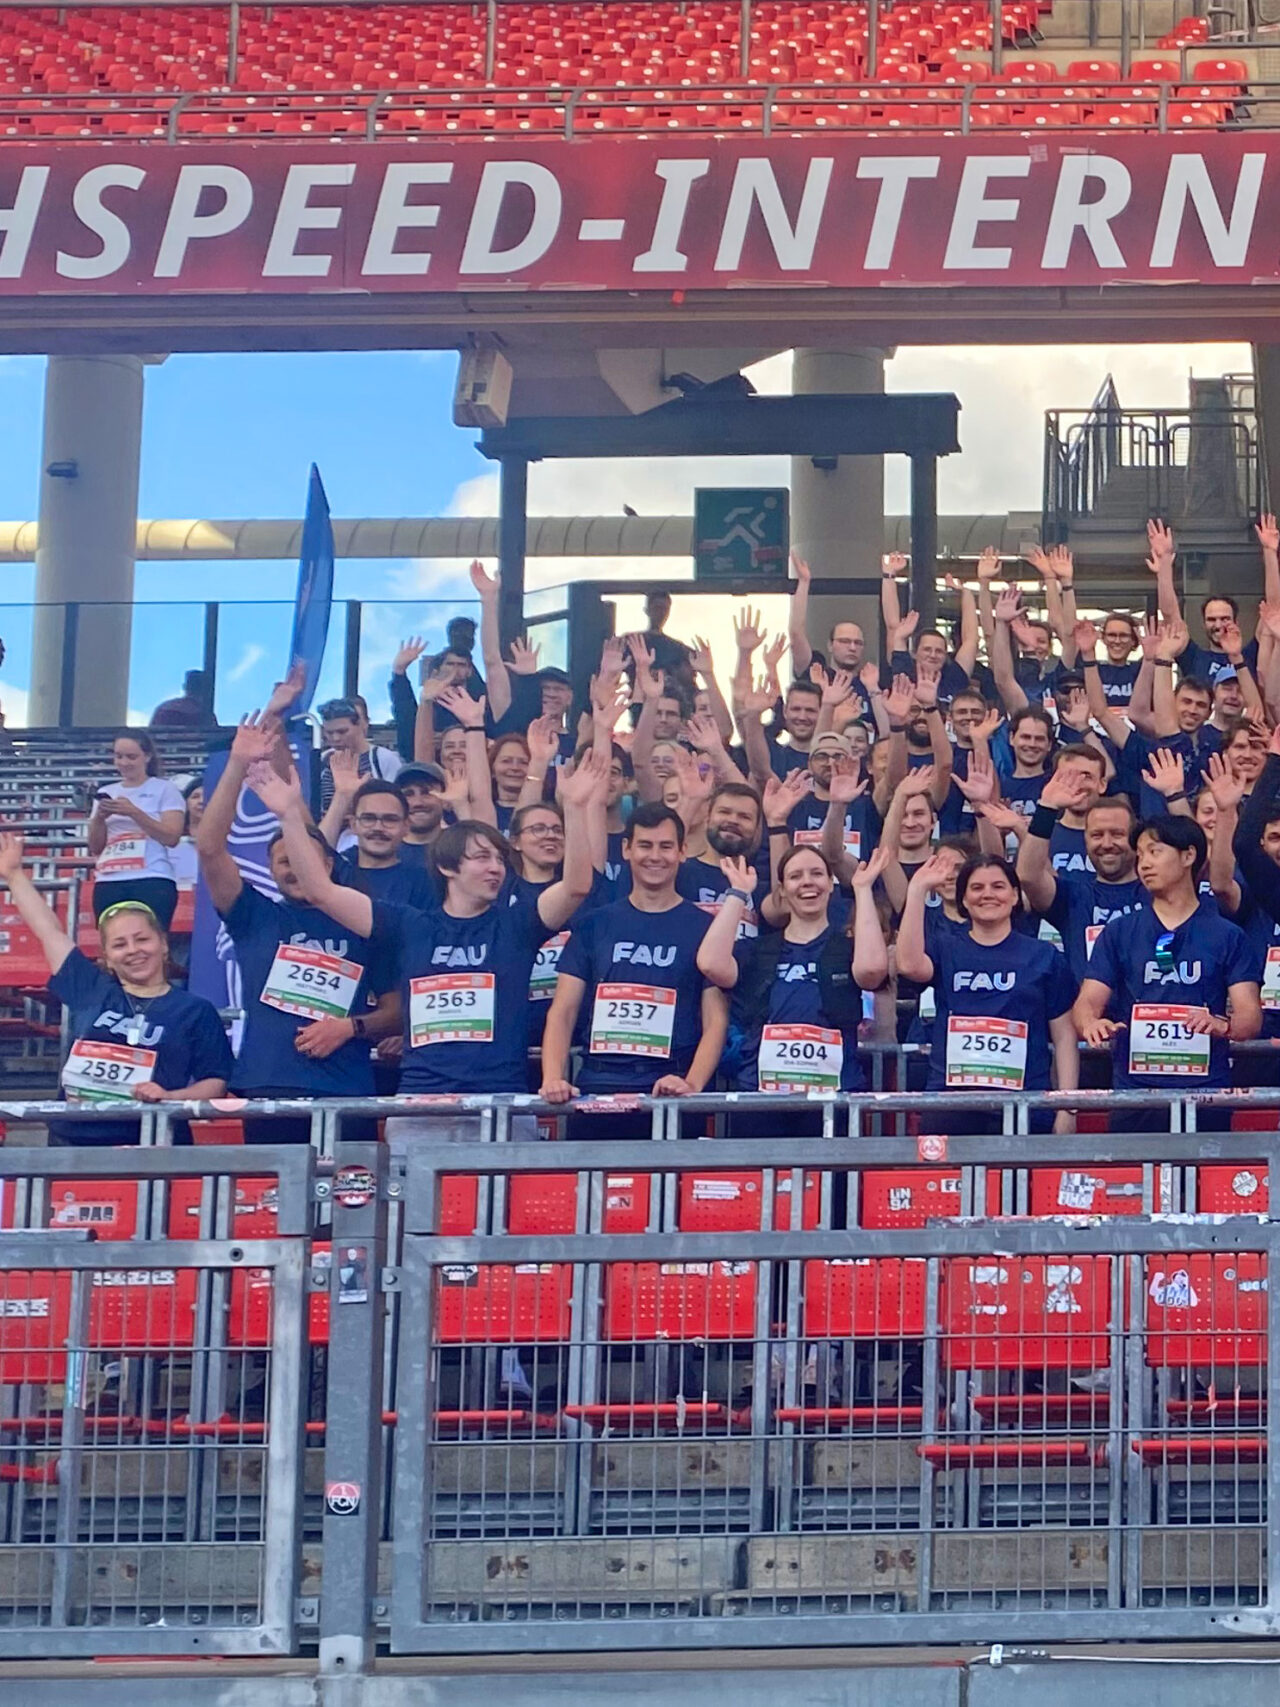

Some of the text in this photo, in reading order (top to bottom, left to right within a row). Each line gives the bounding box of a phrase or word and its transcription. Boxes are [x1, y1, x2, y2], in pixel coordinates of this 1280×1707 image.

[431, 943, 487, 967] FAU
[613, 942, 677, 967] FAU
[287, 964, 341, 990] 2654
[953, 971, 1016, 992] FAU
[1144, 960, 1202, 986] FAU
[425, 991, 477, 1010] 2563
[607, 1001, 658, 1020] 2537
[93, 1010, 164, 1046] FAU
[1144, 1022, 1195, 1040] 2619
[776, 1042, 828, 1061] 2604
[961, 1035, 1012, 1053] 2562
[81, 1059, 135, 1083] 2587
[331, 1496, 356, 1507] FCN
